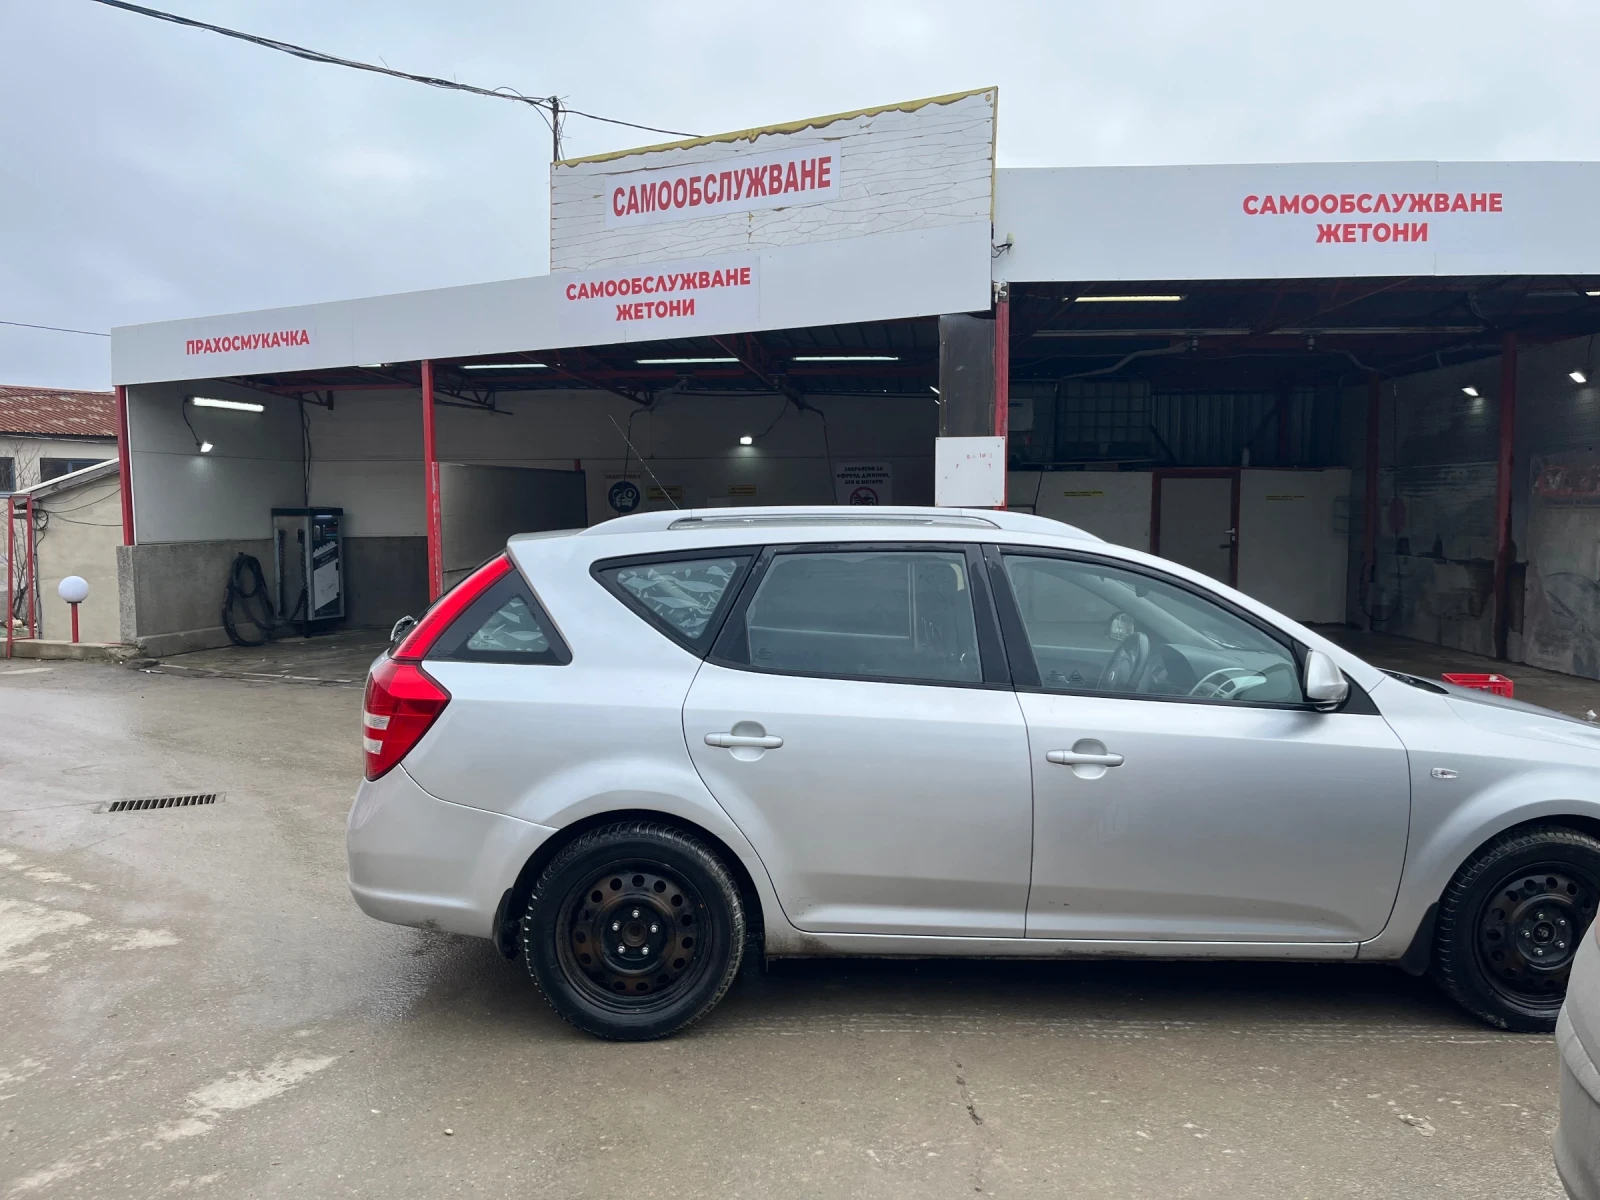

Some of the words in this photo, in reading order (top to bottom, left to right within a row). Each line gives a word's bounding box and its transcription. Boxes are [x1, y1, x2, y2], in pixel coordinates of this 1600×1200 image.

[613, 156, 832, 217] САМООБСЛУЖВАНЕ
[1243, 192, 1503, 215] САМООБСЛУЖВАНЕ
[1316, 222, 1428, 243] ЖЕТОНИ
[566, 267, 751, 301] САМООБСЛУЖВАНЕ
[615, 298, 695, 321] ЖЕТОНИ
[186, 329, 310, 355] ПРАХОСМУКАЧКА
